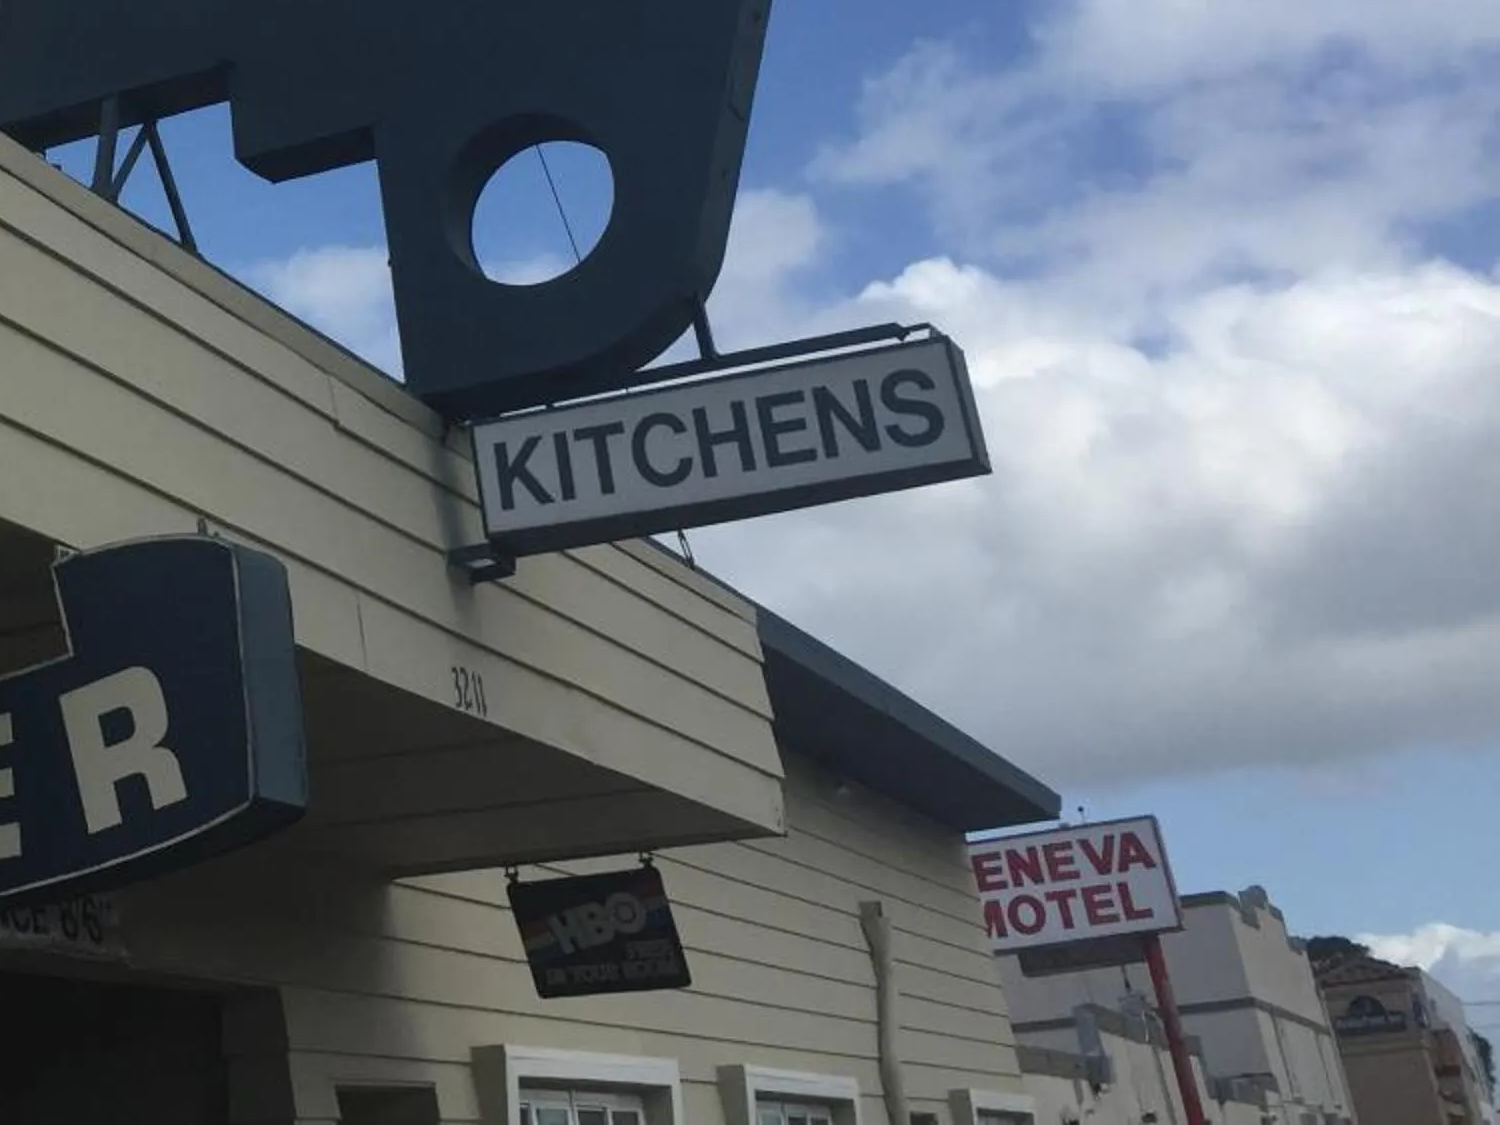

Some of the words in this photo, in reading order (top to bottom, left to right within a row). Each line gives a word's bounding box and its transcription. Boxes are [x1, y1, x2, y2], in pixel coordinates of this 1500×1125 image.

[492, 369, 946, 511] KITCHENS
[451, 666, 488, 717] 3211
[970, 831, 1157, 893] ENEVA
[547, 892, 647, 954] HBO
